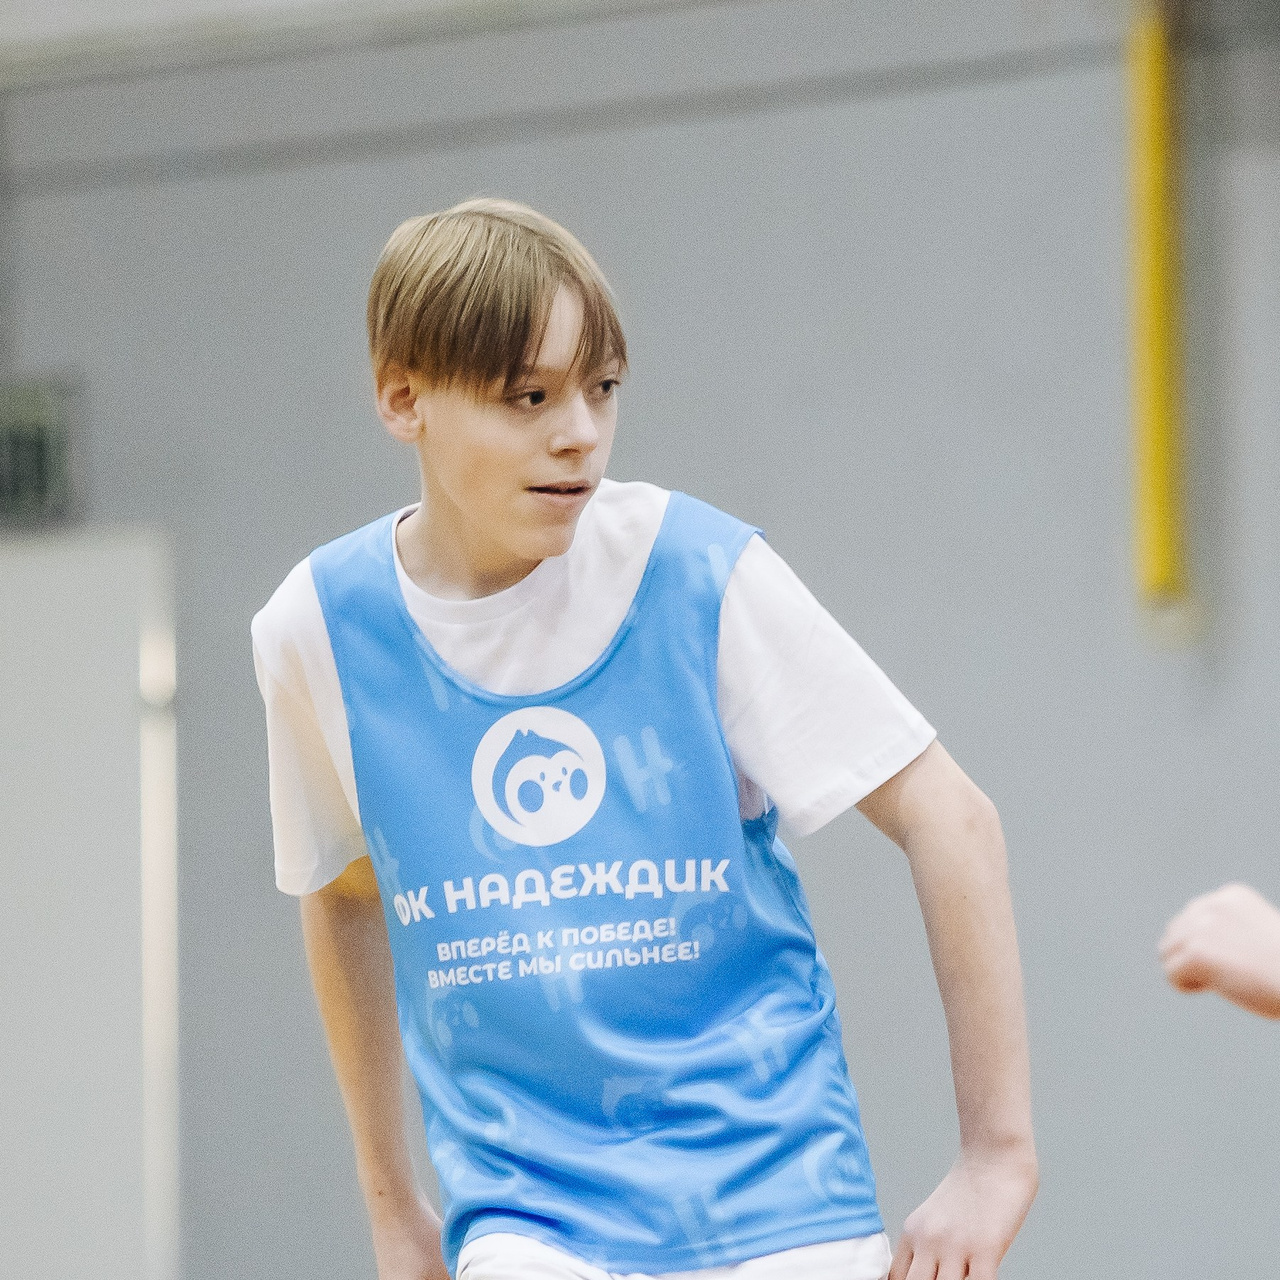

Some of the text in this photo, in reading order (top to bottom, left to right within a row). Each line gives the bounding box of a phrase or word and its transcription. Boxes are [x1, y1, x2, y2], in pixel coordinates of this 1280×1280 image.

[443, 858, 730, 912] НАДЕЖДИК
[436, 917, 677, 962] ВПЕРЁД К ПОБЕДЕ!
[427, 941, 700, 989] ВМЕСТЕ МЫ СИЛЬНЕЕ!
